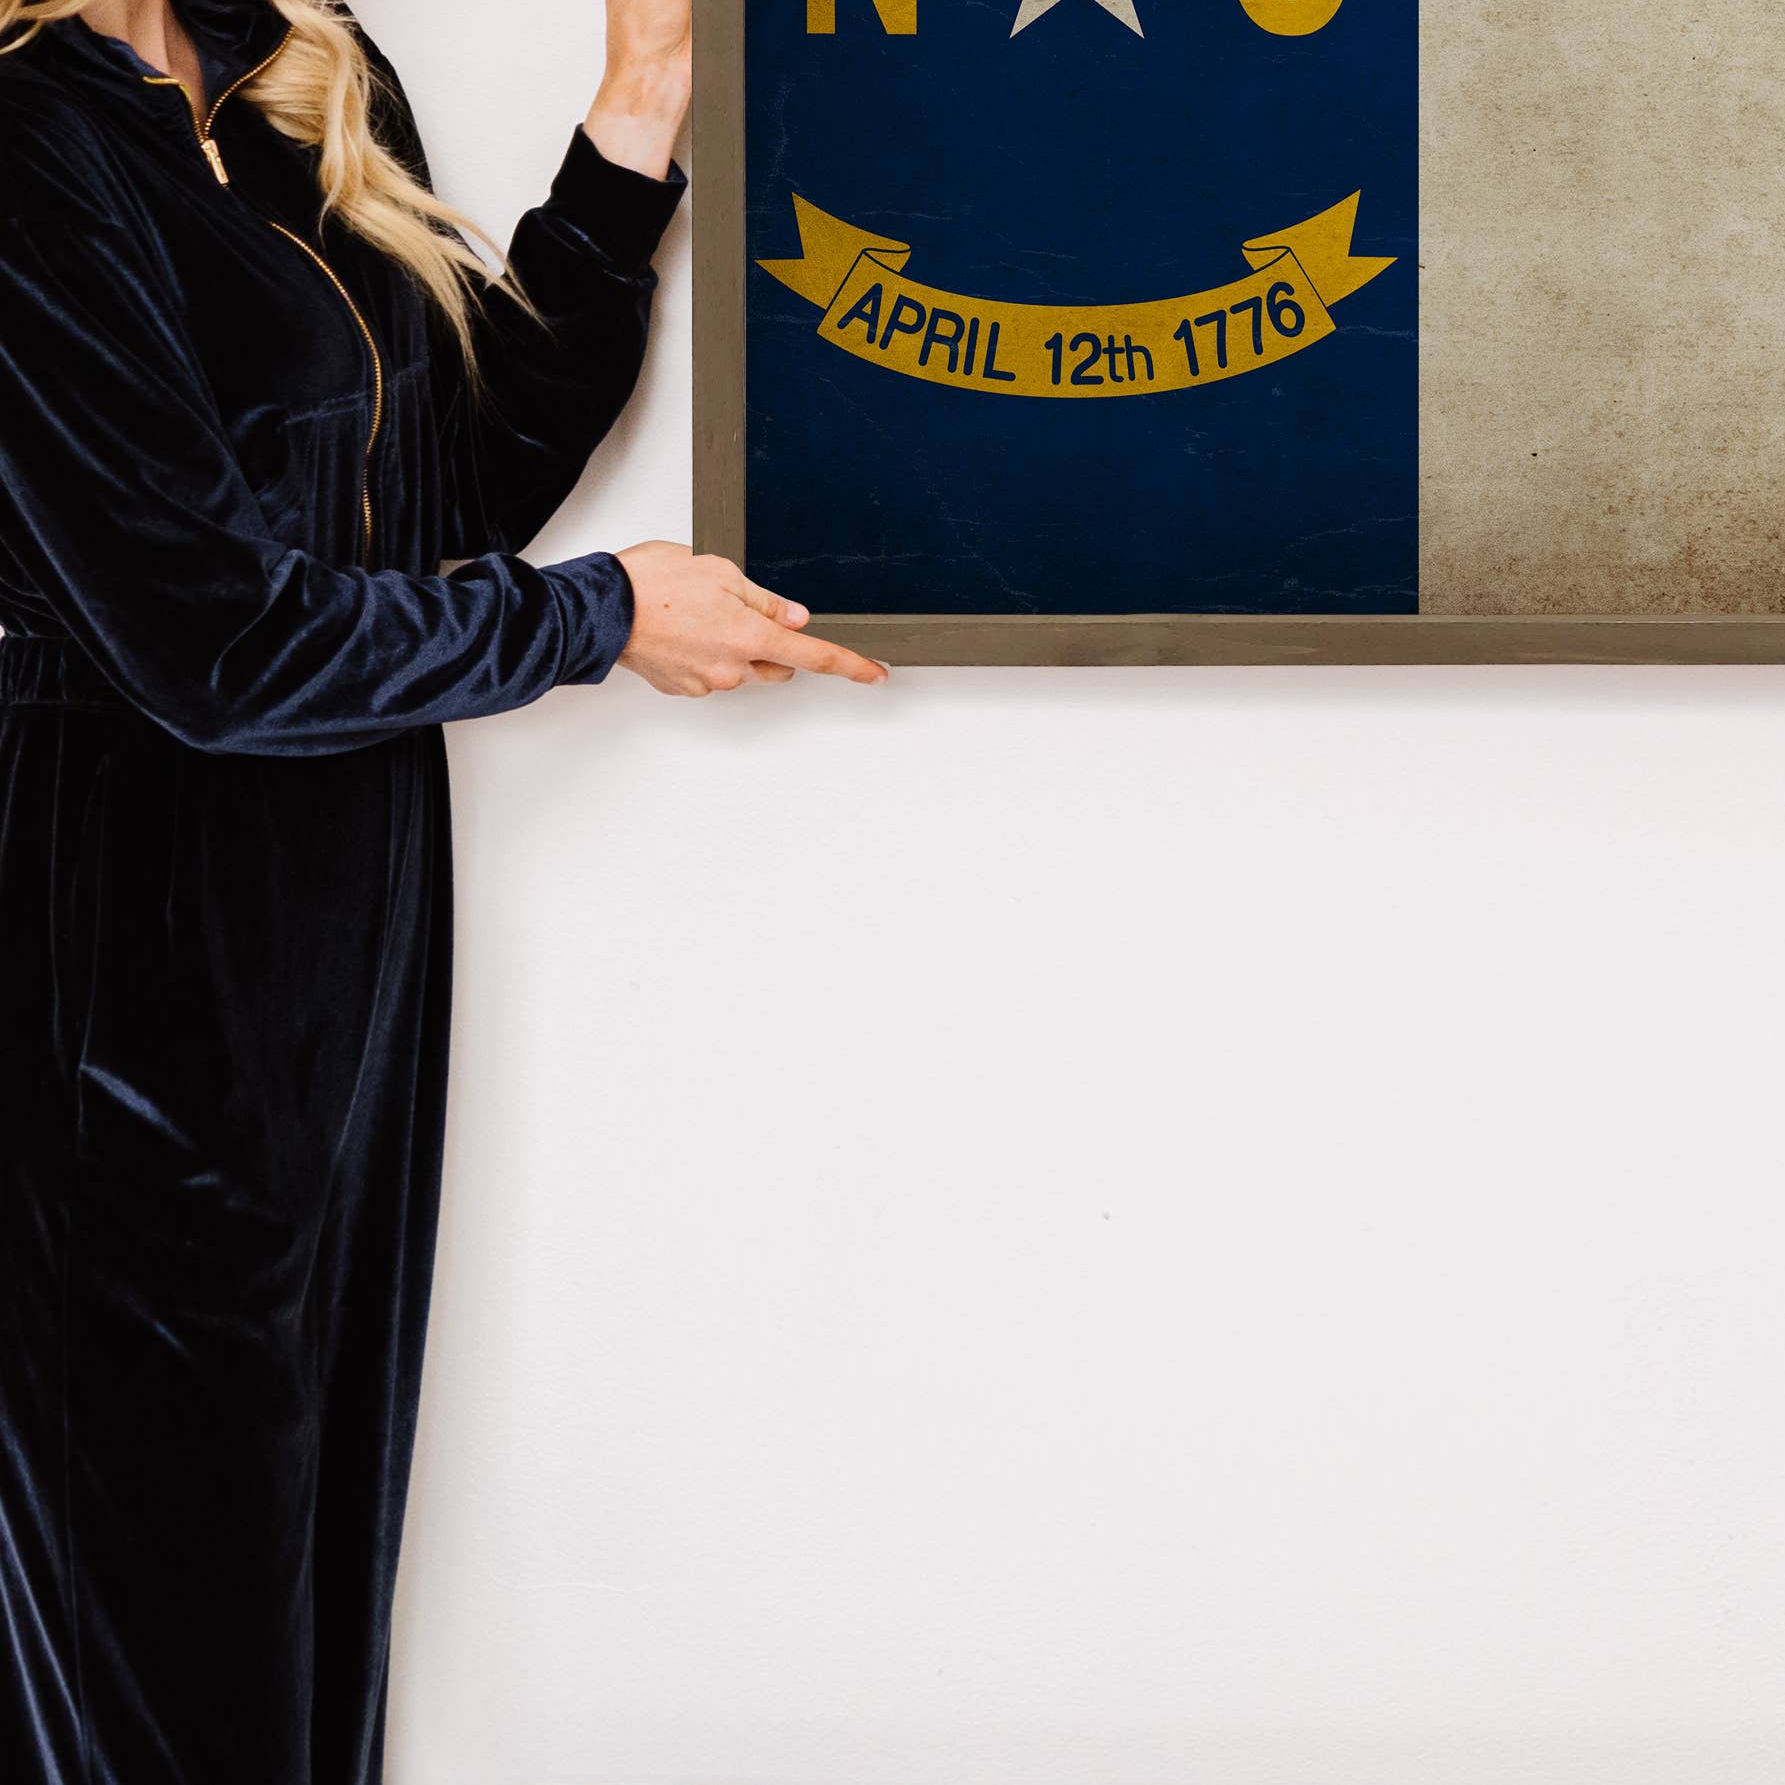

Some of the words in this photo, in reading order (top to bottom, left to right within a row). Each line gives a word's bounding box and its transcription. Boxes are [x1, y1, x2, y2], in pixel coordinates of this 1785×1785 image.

[838, 282, 1016, 381] APRIL
[1045, 332, 1154, 385] 12th
[1173, 281, 1305, 377] 1776
